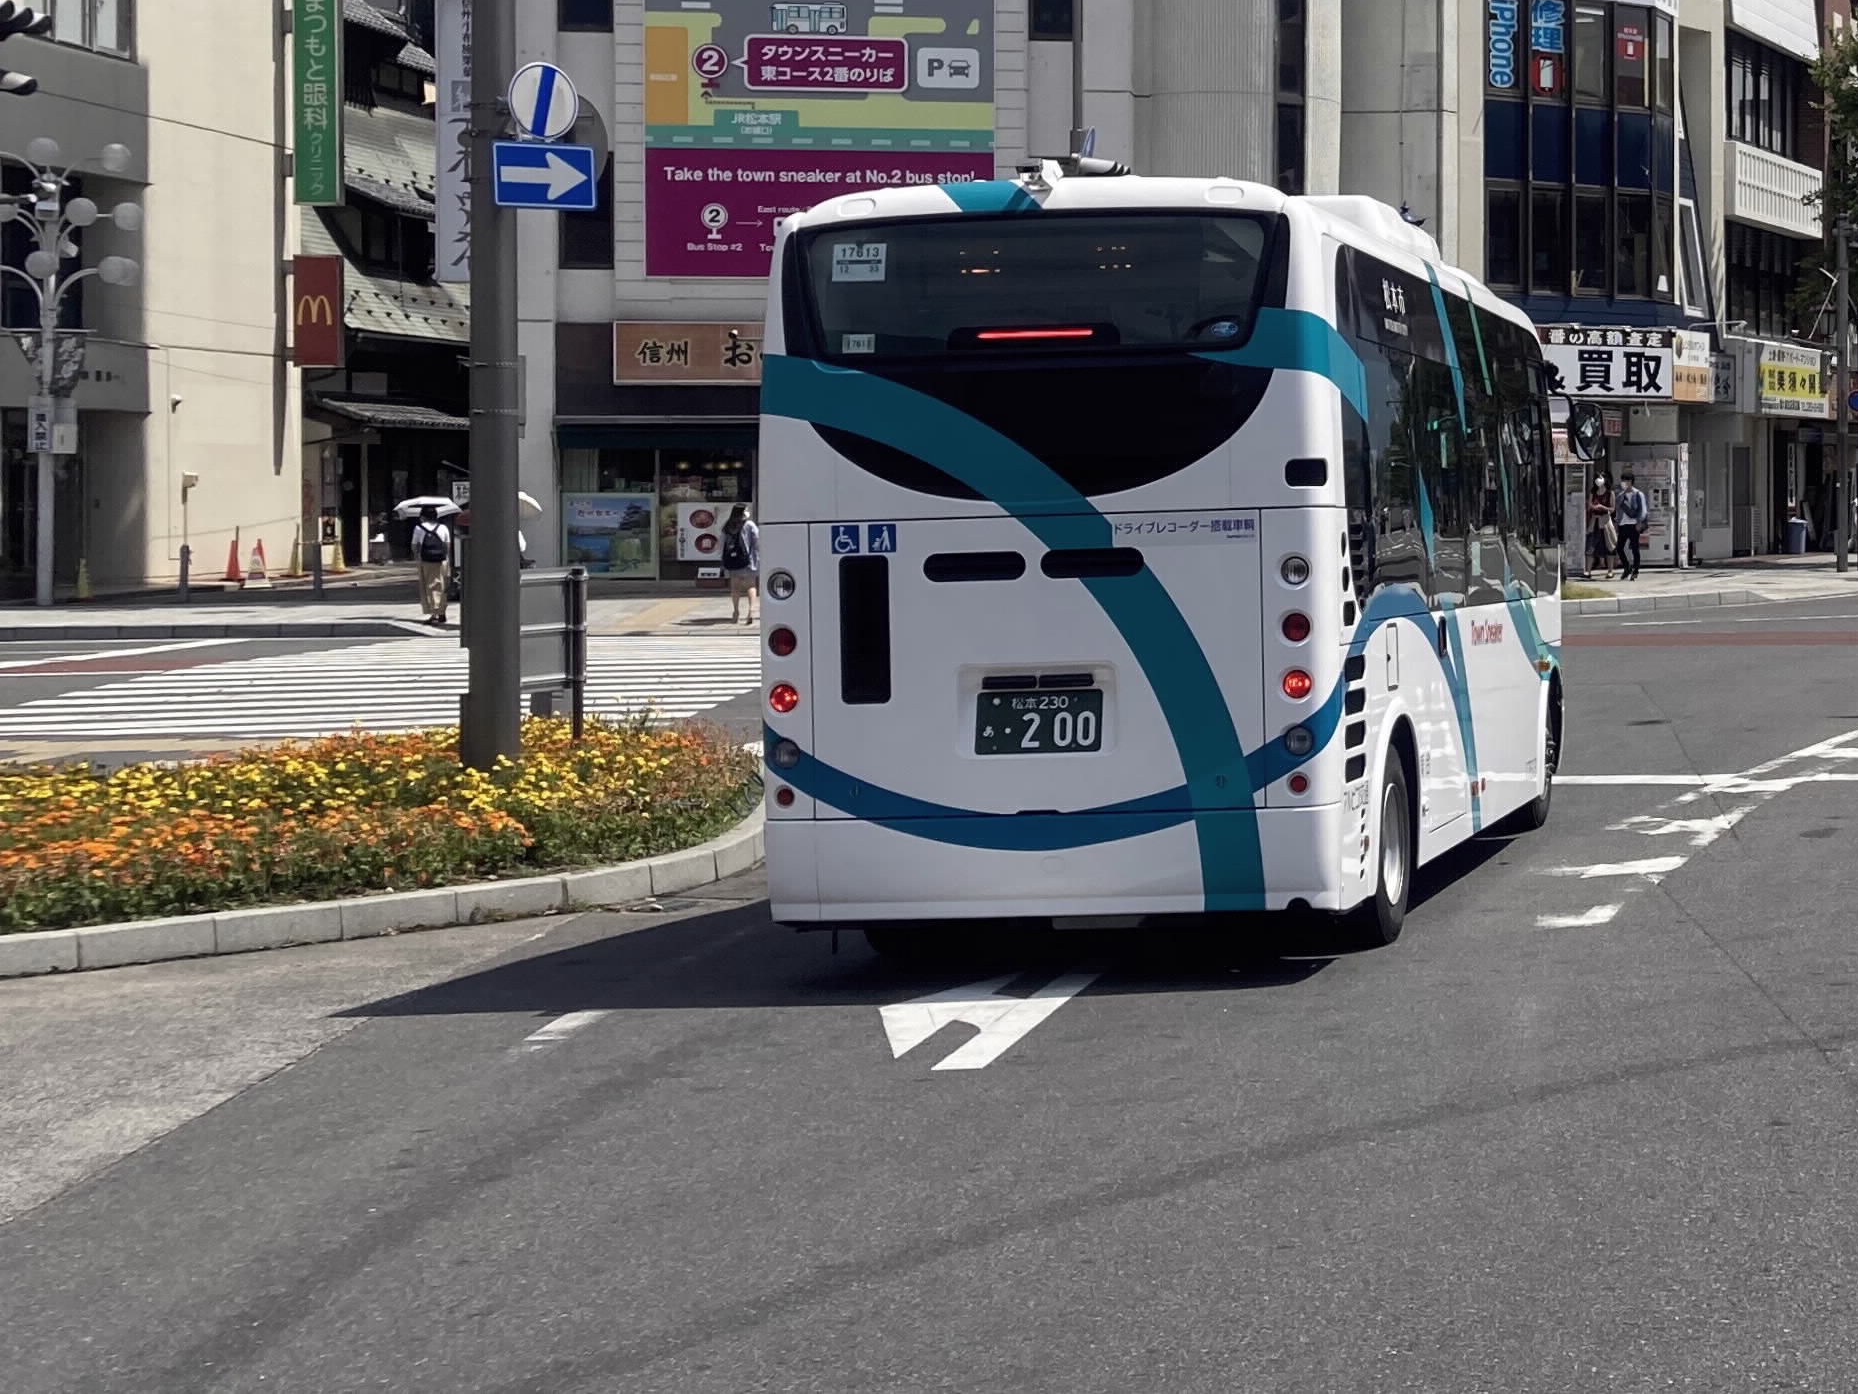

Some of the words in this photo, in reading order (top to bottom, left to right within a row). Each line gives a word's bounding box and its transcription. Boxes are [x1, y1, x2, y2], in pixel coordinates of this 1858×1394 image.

[703, 51, 719, 72] 2
[761, 46, 894, 62] タウンスニーカー
[760, 65, 895, 84] 東コース2番のりば
[927, 58, 945, 78] P
[731, 112, 782, 127] JR松本駅
[664, 167, 703, 183] Take
[707, 168, 733, 183] the
[737, 169, 774, 184] town
[779, 169, 841, 184] sneaker
[845, 171, 862, 183] at
[866, 170, 902, 184] No.2
[906, 170, 933, 184] bus
[938, 171, 975, 185] stop!
[707, 208, 721, 223] 2
[687, 242, 705, 252] Bus
[707, 242, 728, 252] Stop
[639, 341, 690, 366] 信州
[723, 339, 762, 367] お
[1576, 349, 1663, 394] 買取
[1011, 695, 1069, 710] 松本230
